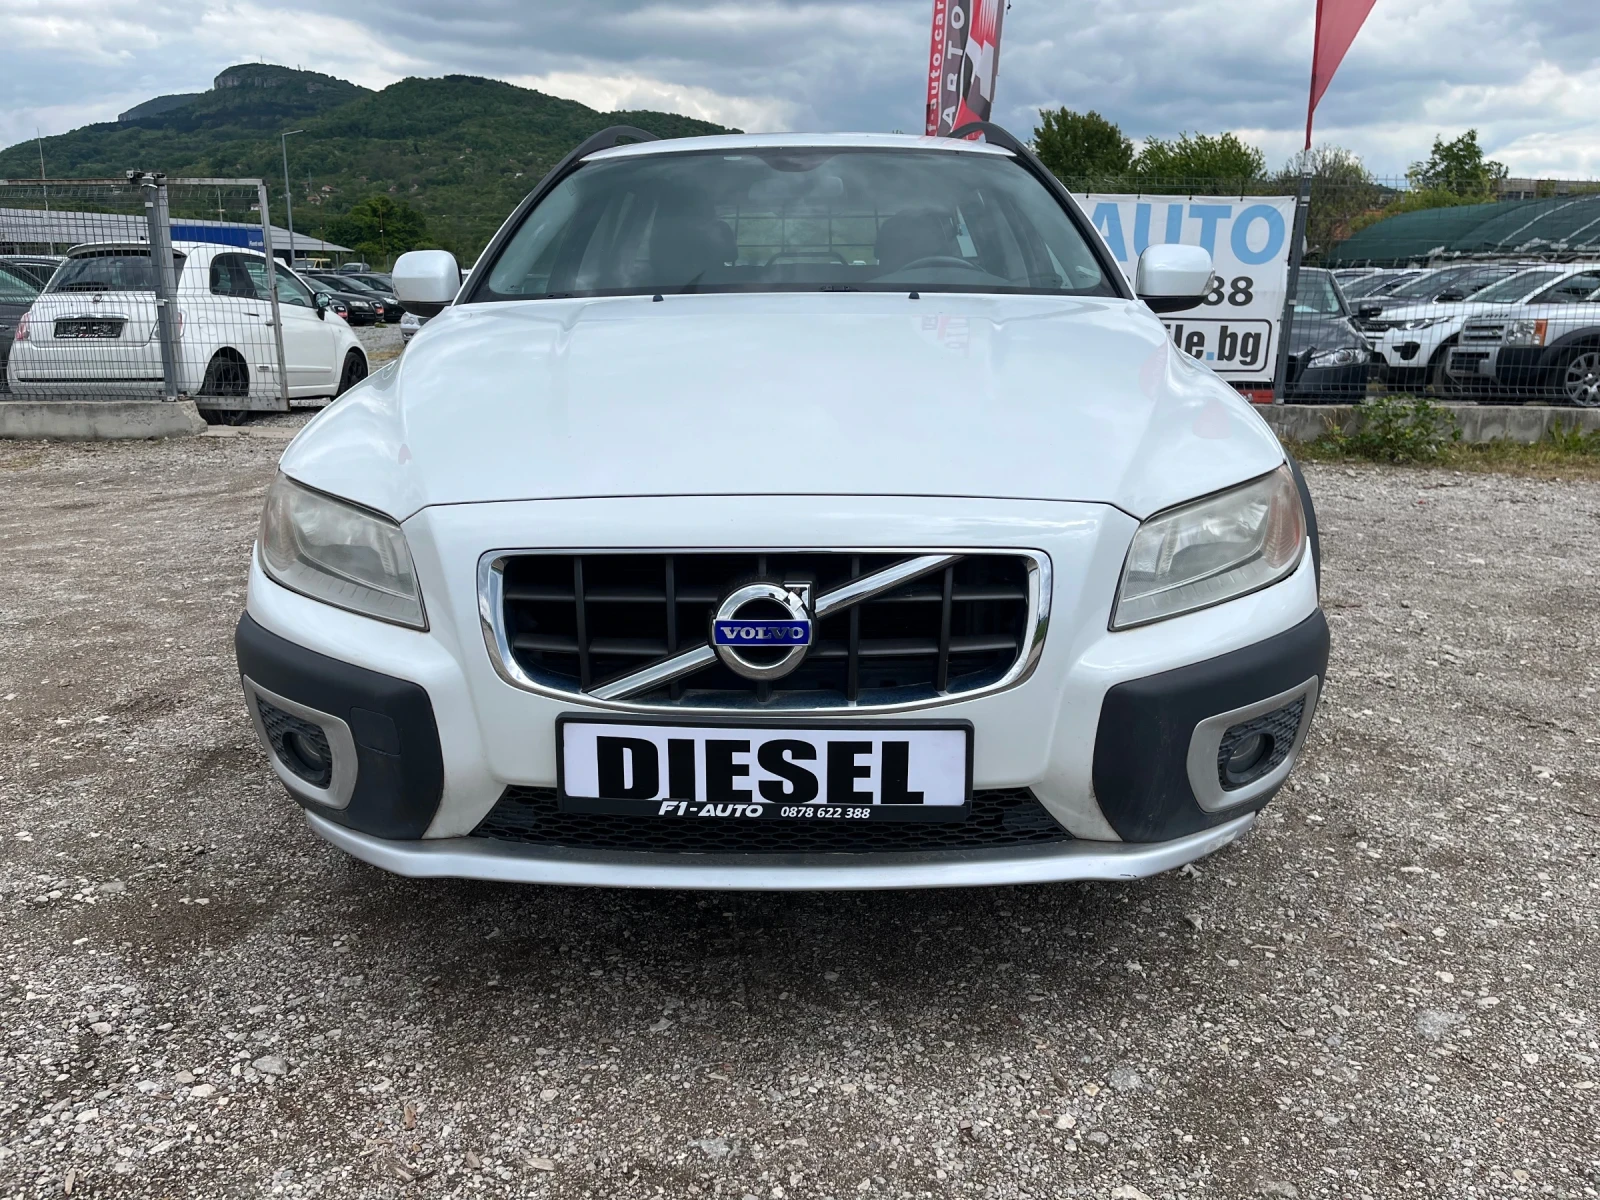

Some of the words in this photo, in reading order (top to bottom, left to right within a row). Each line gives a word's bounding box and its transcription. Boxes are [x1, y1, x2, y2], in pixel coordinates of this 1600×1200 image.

[1091, 202, 1285, 265] AUTO
[720, 627, 804, 640] VOLVO
[597, 735, 925, 805] DIESEL
[658, 801, 764, 818] F1-AUTO
[780, 806, 814, 818] 0878
[817, 807, 842, 819] 622
[845, 807, 871, 819] 388
